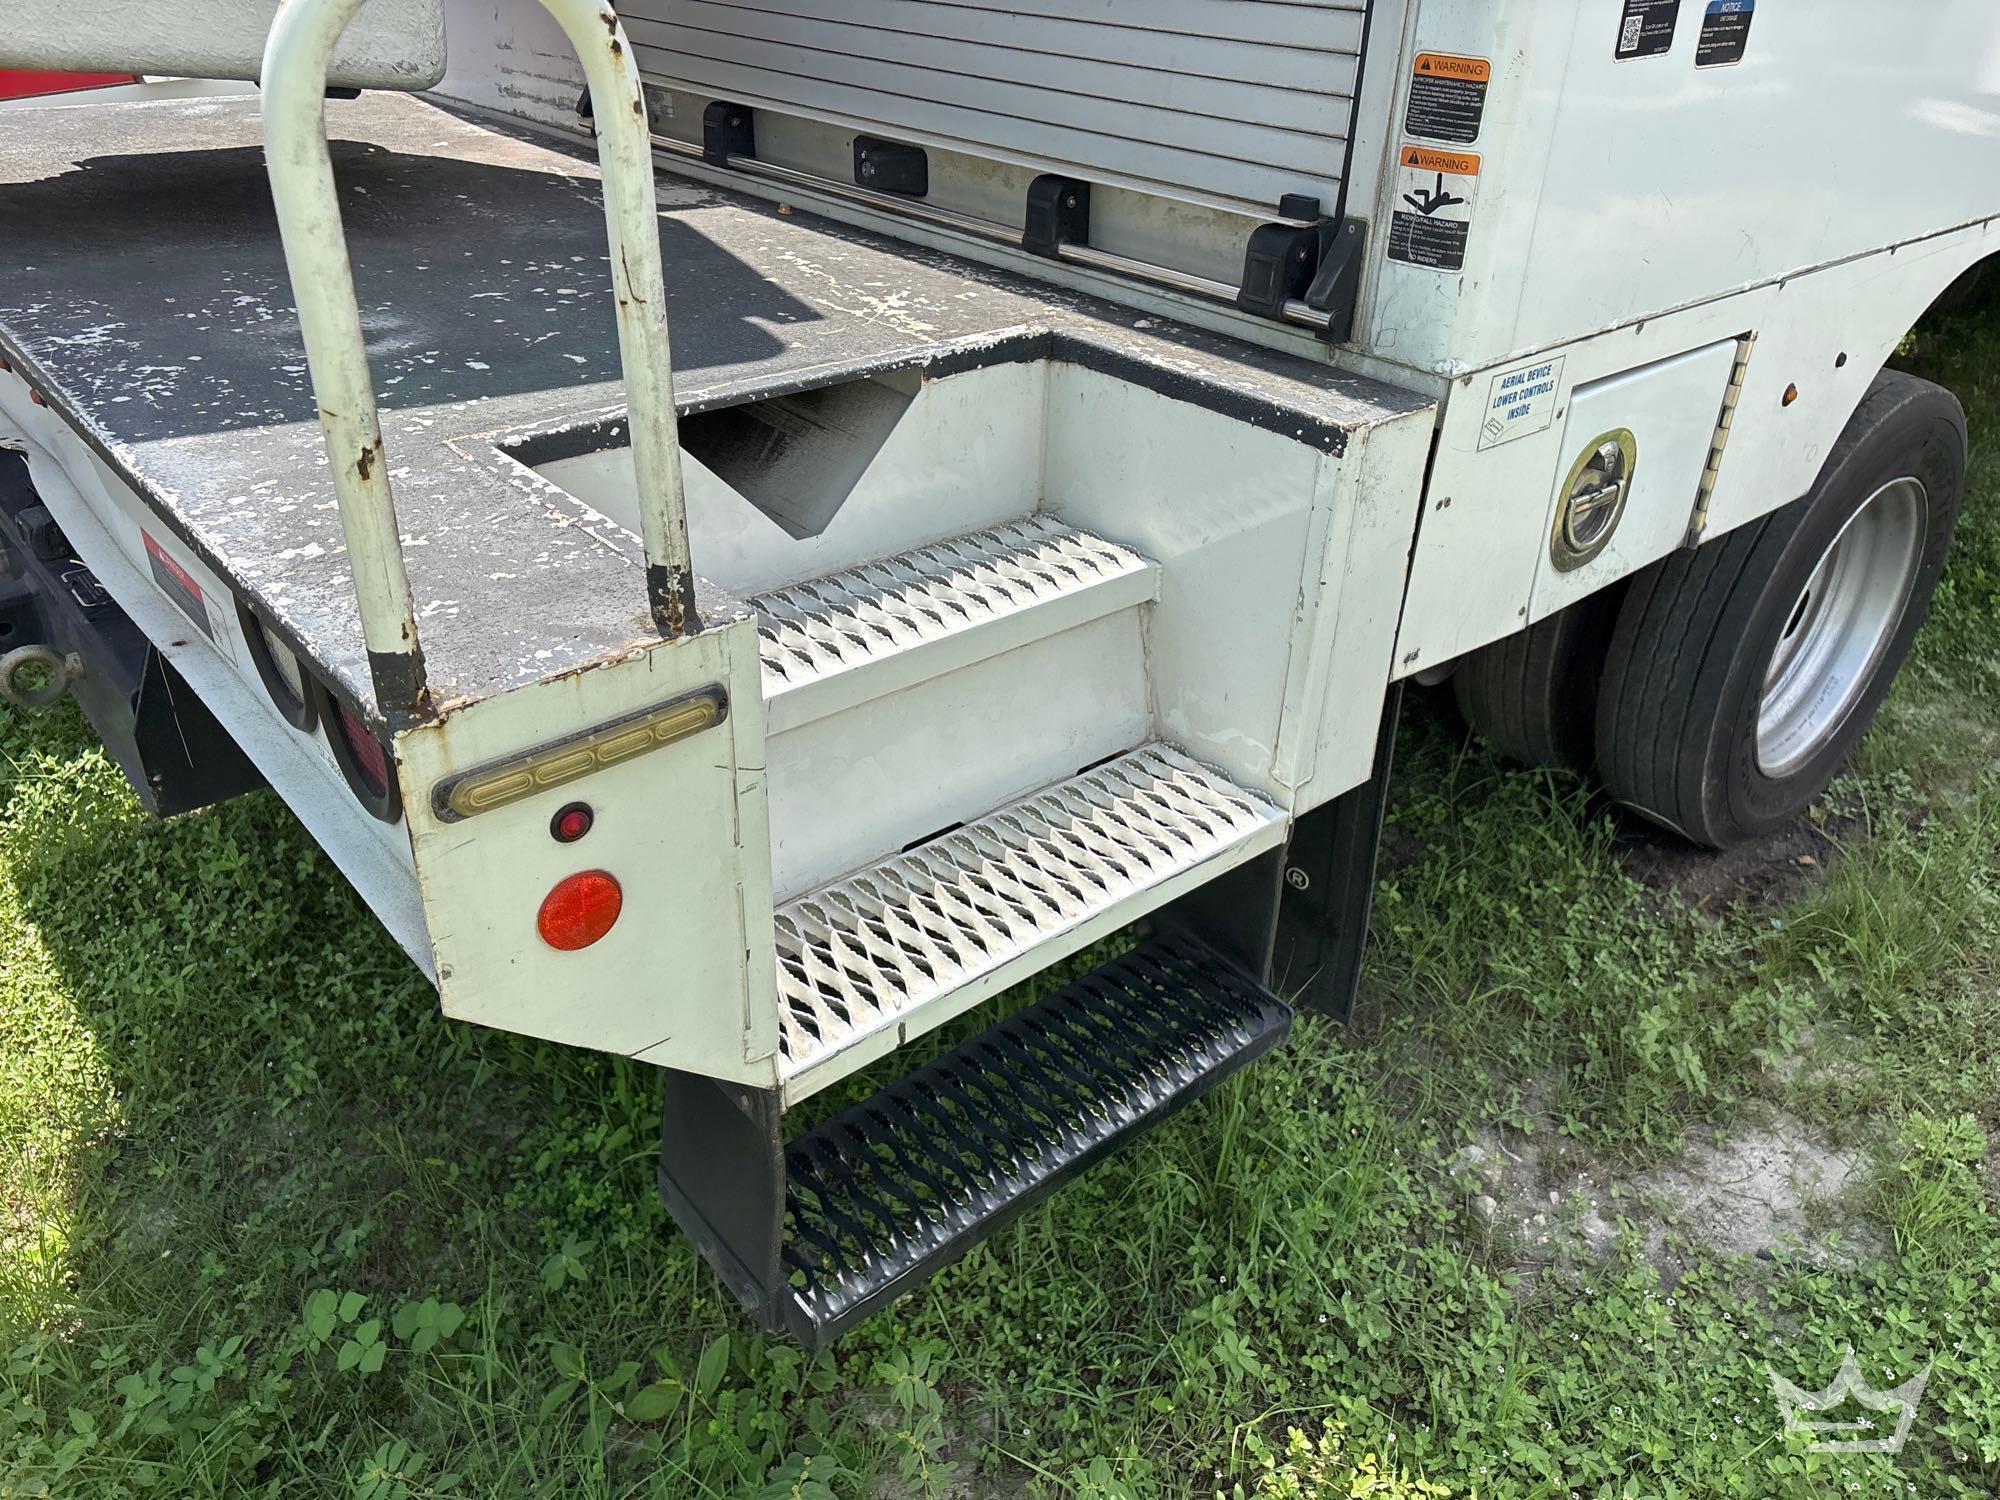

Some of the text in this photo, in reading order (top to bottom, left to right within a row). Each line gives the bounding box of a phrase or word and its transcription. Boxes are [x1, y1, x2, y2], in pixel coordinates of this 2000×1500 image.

[1721, 2, 1743, 12] NOTICE
[1434, 60, 1483, 75] WARNING
[1420, 155, 1469, 170] WARNING
[1434, 219, 1458, 229] HAZARD
[1417, 255, 1437, 264] RIDERS
[1501, 364, 1552, 390] AERIAL DEVICE
[1492, 380, 1554, 409] LOWER CONTROLS
[1507, 403, 1531, 420] INSIDE
